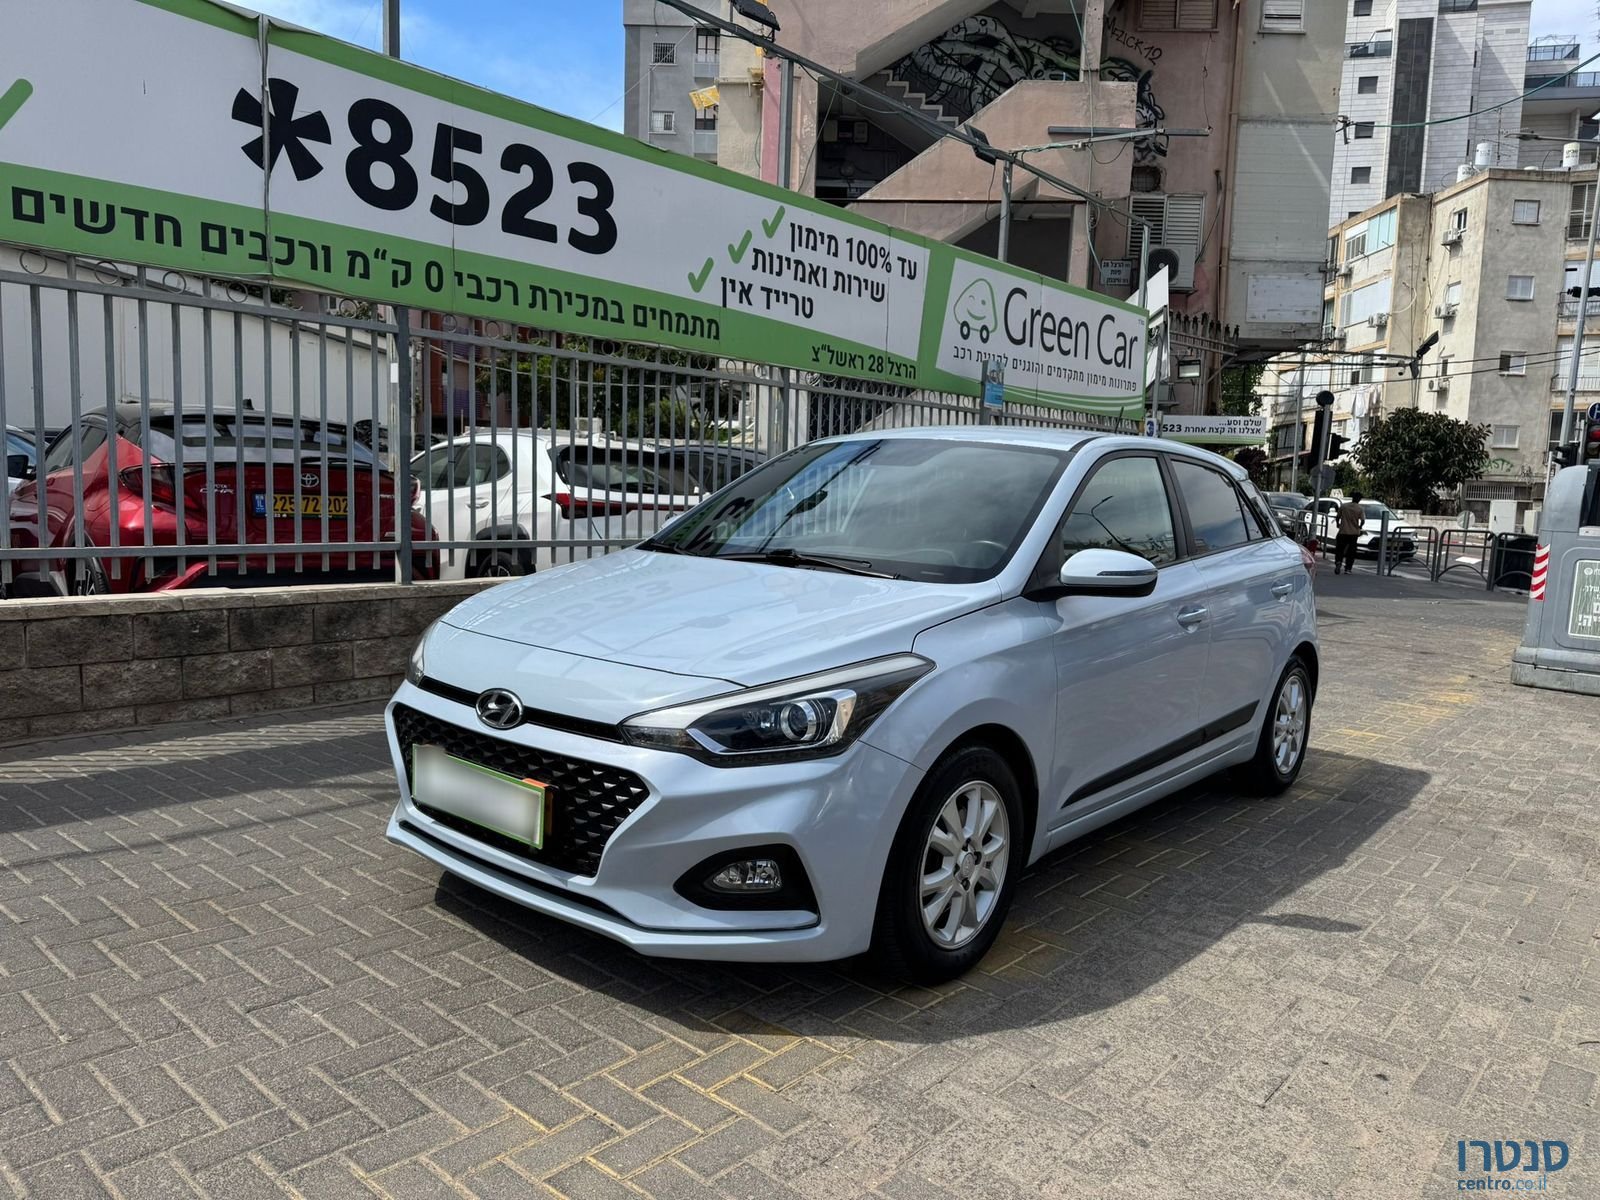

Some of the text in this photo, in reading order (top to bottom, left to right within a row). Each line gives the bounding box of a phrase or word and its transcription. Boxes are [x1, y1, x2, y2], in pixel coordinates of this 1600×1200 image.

[12, 186, 182, 247] חדשים
[200, 221, 331, 273] ורכבים
[790, 222, 917, 280] עד 100% מימון
[425, 261, 444, 292] 0
[454, 271, 519, 305] רכבי
[752, 248, 885, 303] שירות ואמינות
[529, 284, 625, 324] במכירת
[721, 276, 814, 319] טרייד אין
[633, 304, 721, 341] מתמחים
[1004, 287, 1138, 370] Green Car
[868, 354, 884, 374] 28
[953, 346, 972, 361] רכב
[1012, 358, 1044, 375] והוגנים
[887, 357, 916, 380] הרצל
[1047, 365, 1084, 383] מתקדמים
[1086, 372, 1106, 387] מימון
[1108, 377, 1137, 392] פתרונות
[1208, 426, 1226, 435] קצת
[1239, 426, 1262, 434] אצלנו
[1243, 418, 1262, 427] שלם
